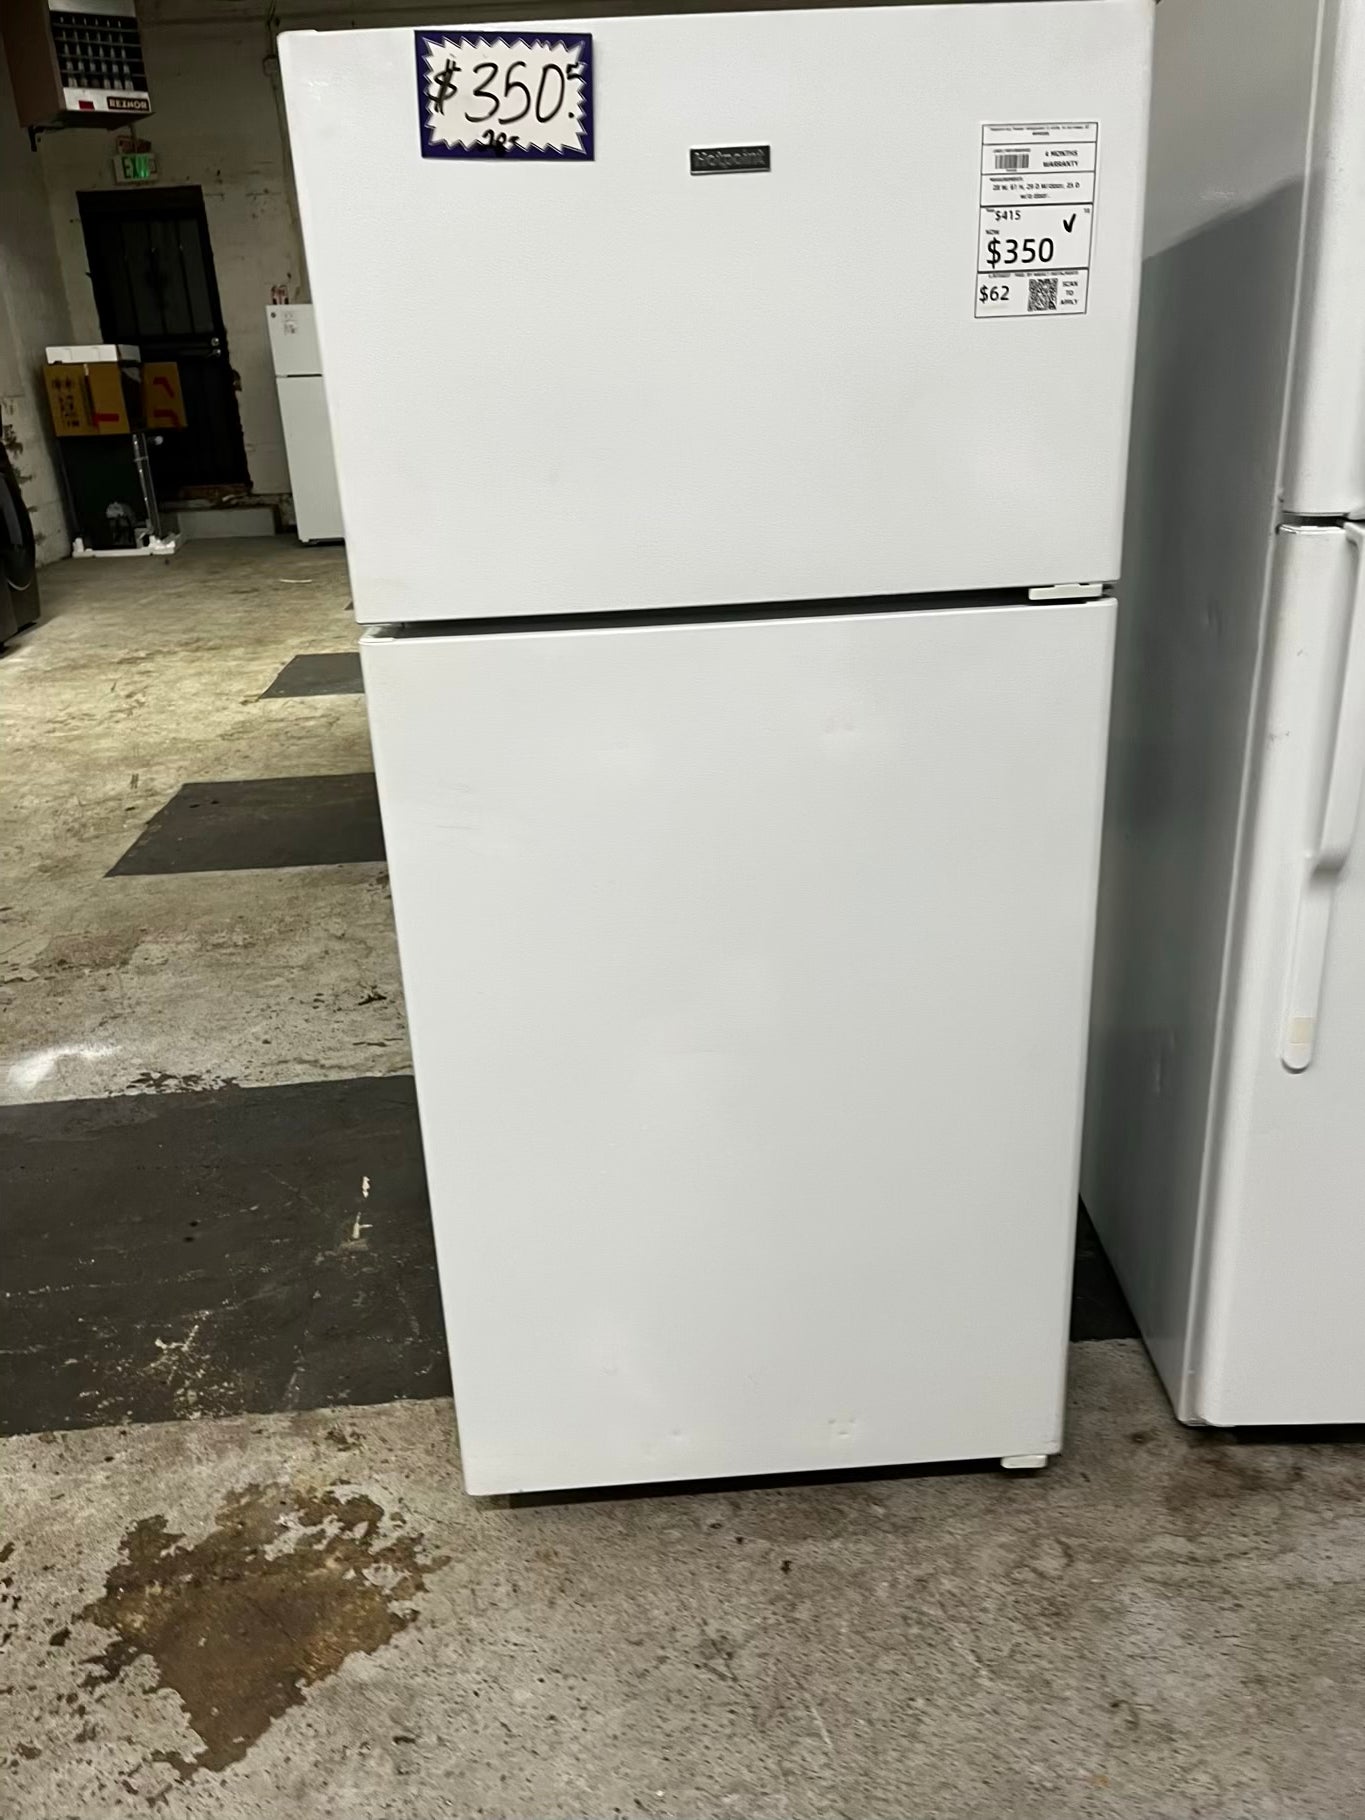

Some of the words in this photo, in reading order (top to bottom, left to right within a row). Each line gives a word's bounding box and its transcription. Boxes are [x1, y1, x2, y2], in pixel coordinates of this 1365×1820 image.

[1050, 149, 1078, 157] MONTHS
[994, 209, 1021, 221] $415
[986, 236, 1054, 270] $350
[979, 284, 1010, 304] $62
